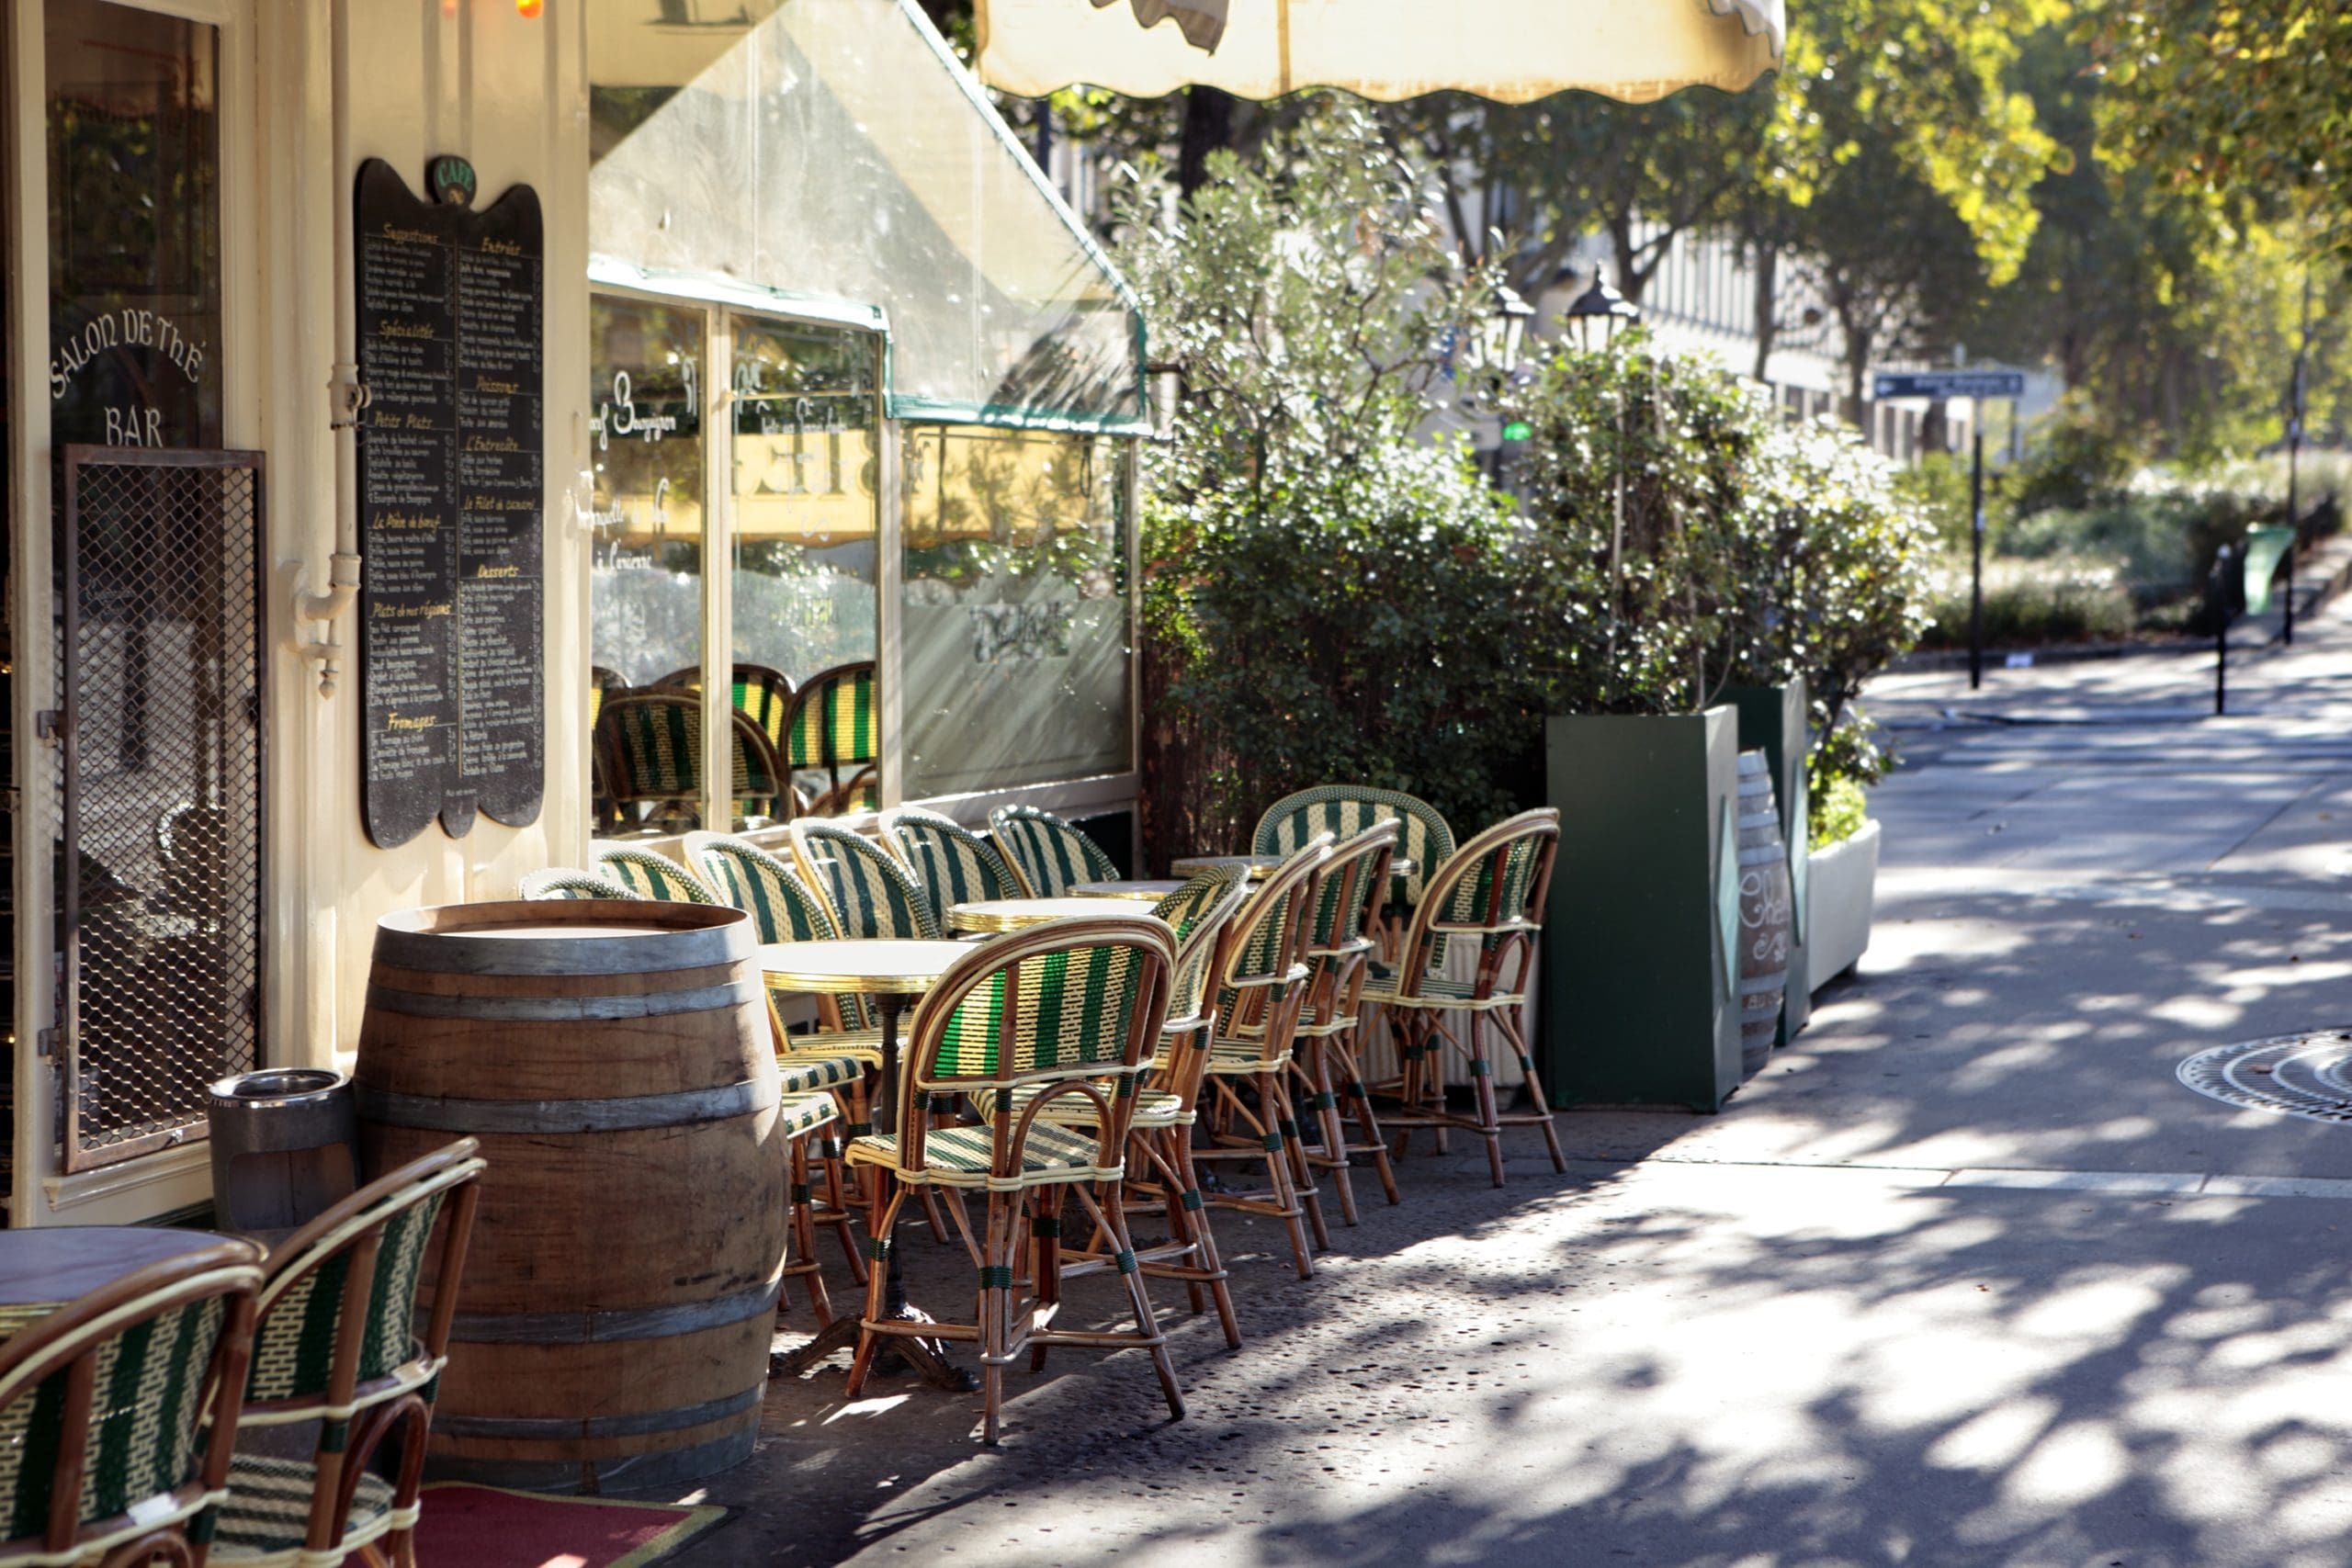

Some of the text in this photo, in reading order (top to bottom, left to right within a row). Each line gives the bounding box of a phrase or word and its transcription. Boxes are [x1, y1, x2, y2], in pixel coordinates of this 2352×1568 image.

[50, 312, 118, 400] SALON
[122, 308, 153, 346] DE
[104, 404, 164, 448] BAR
